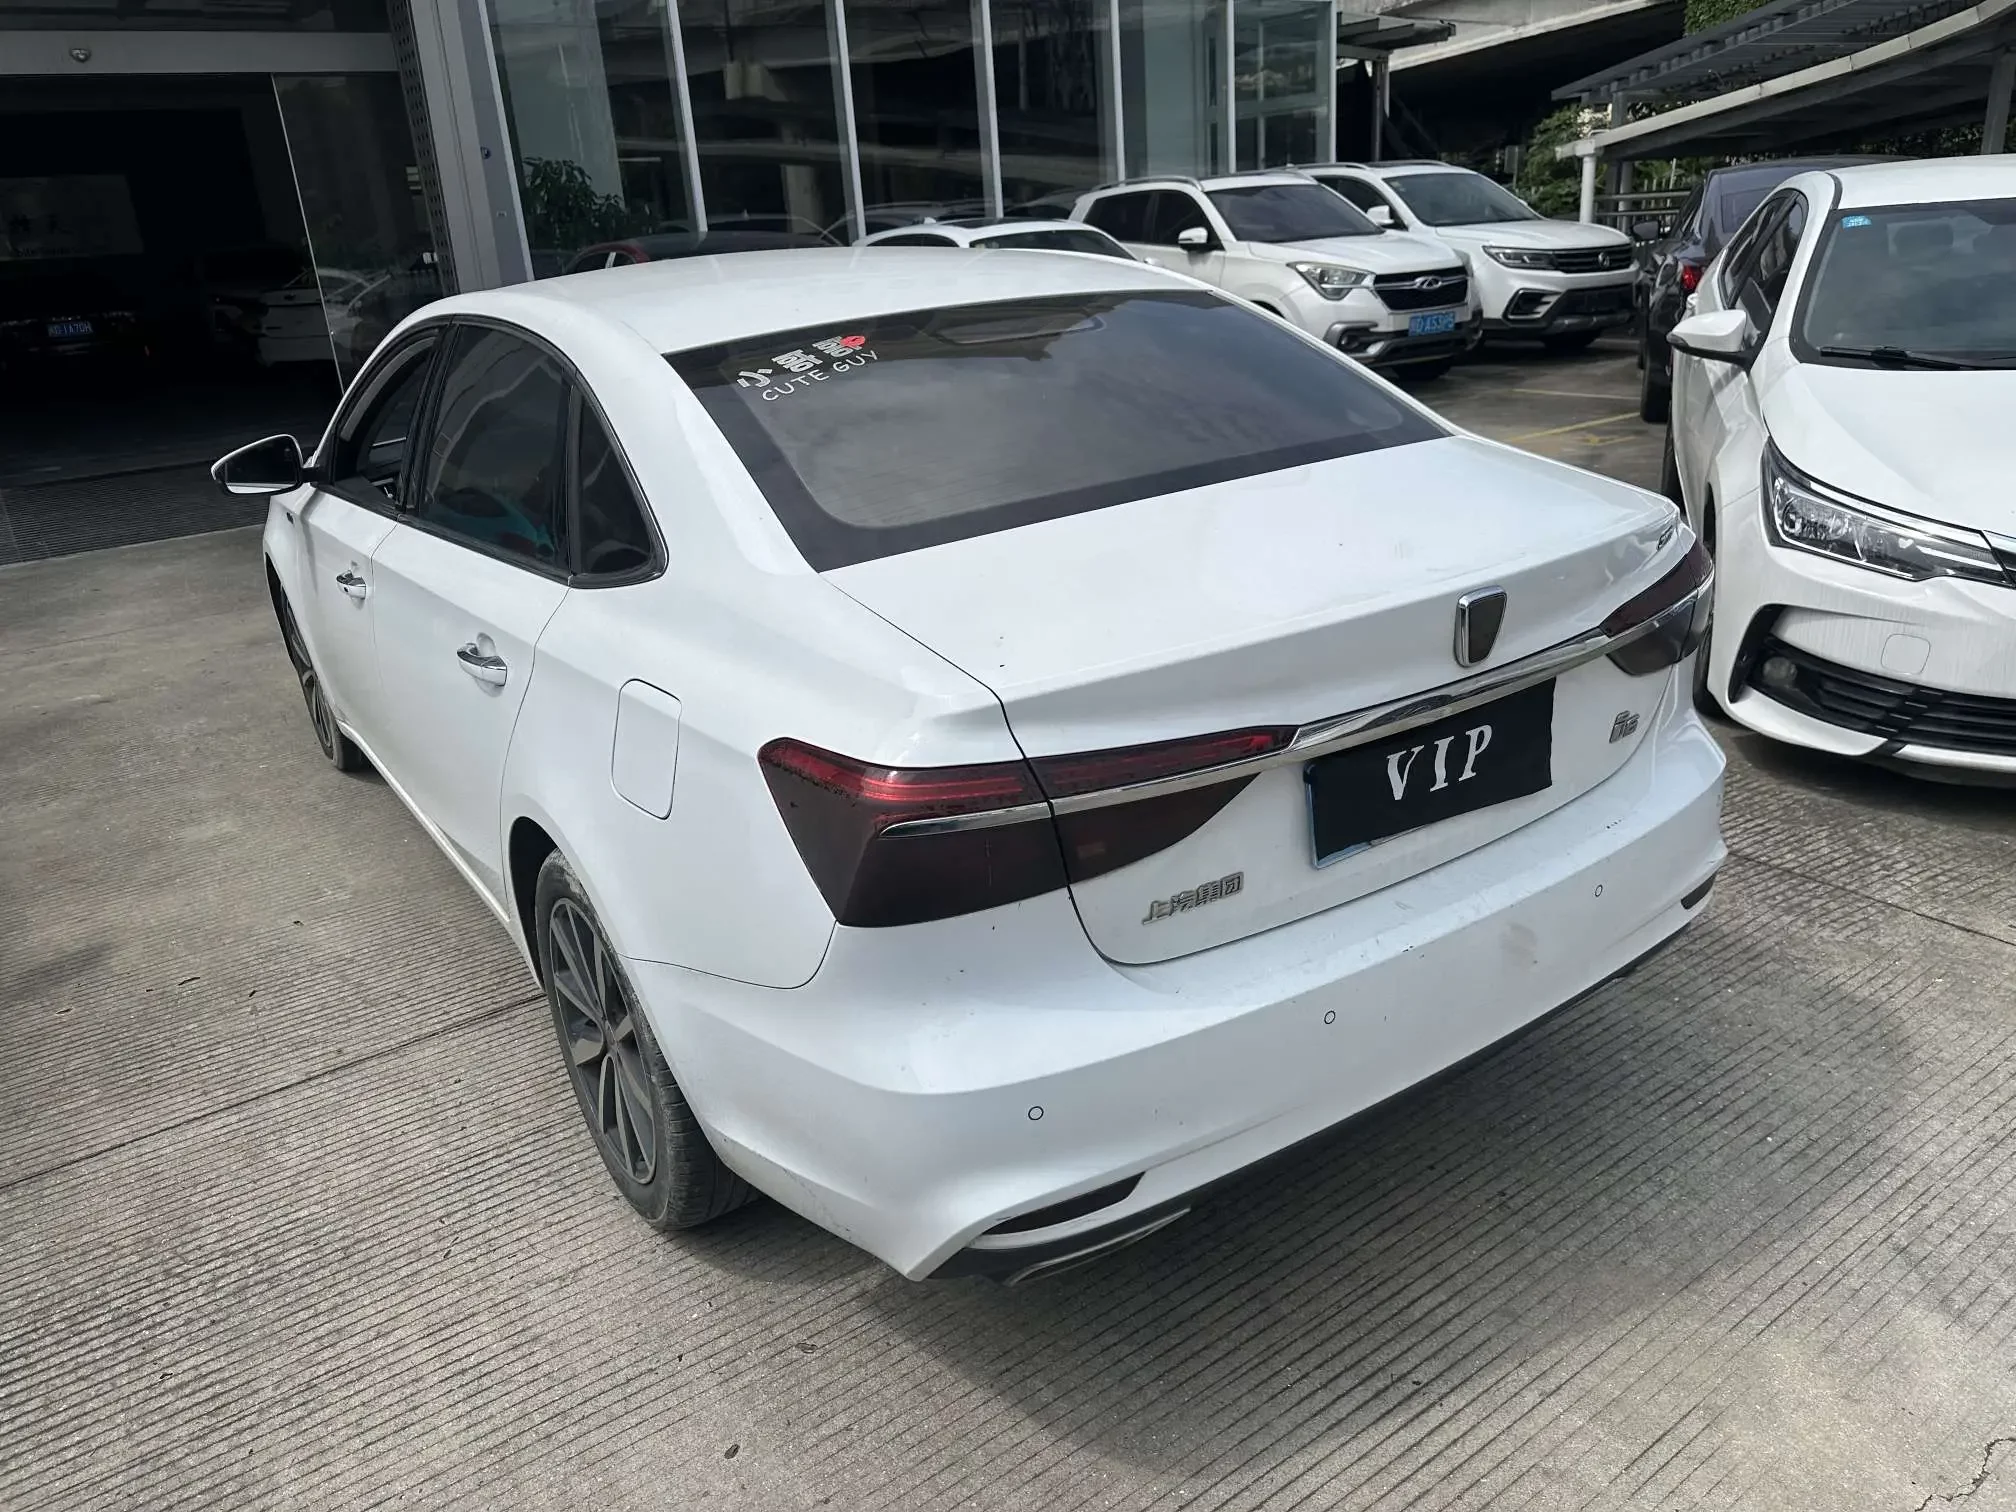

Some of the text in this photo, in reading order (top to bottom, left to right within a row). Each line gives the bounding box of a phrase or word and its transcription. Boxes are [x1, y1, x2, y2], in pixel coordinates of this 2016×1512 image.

[737, 335, 863, 388] 小哥哥
[762, 350, 880, 401] CUTE GUY
[1386, 724, 1493, 801] VIP
[1142, 871, 1244, 926] 上汽集团
